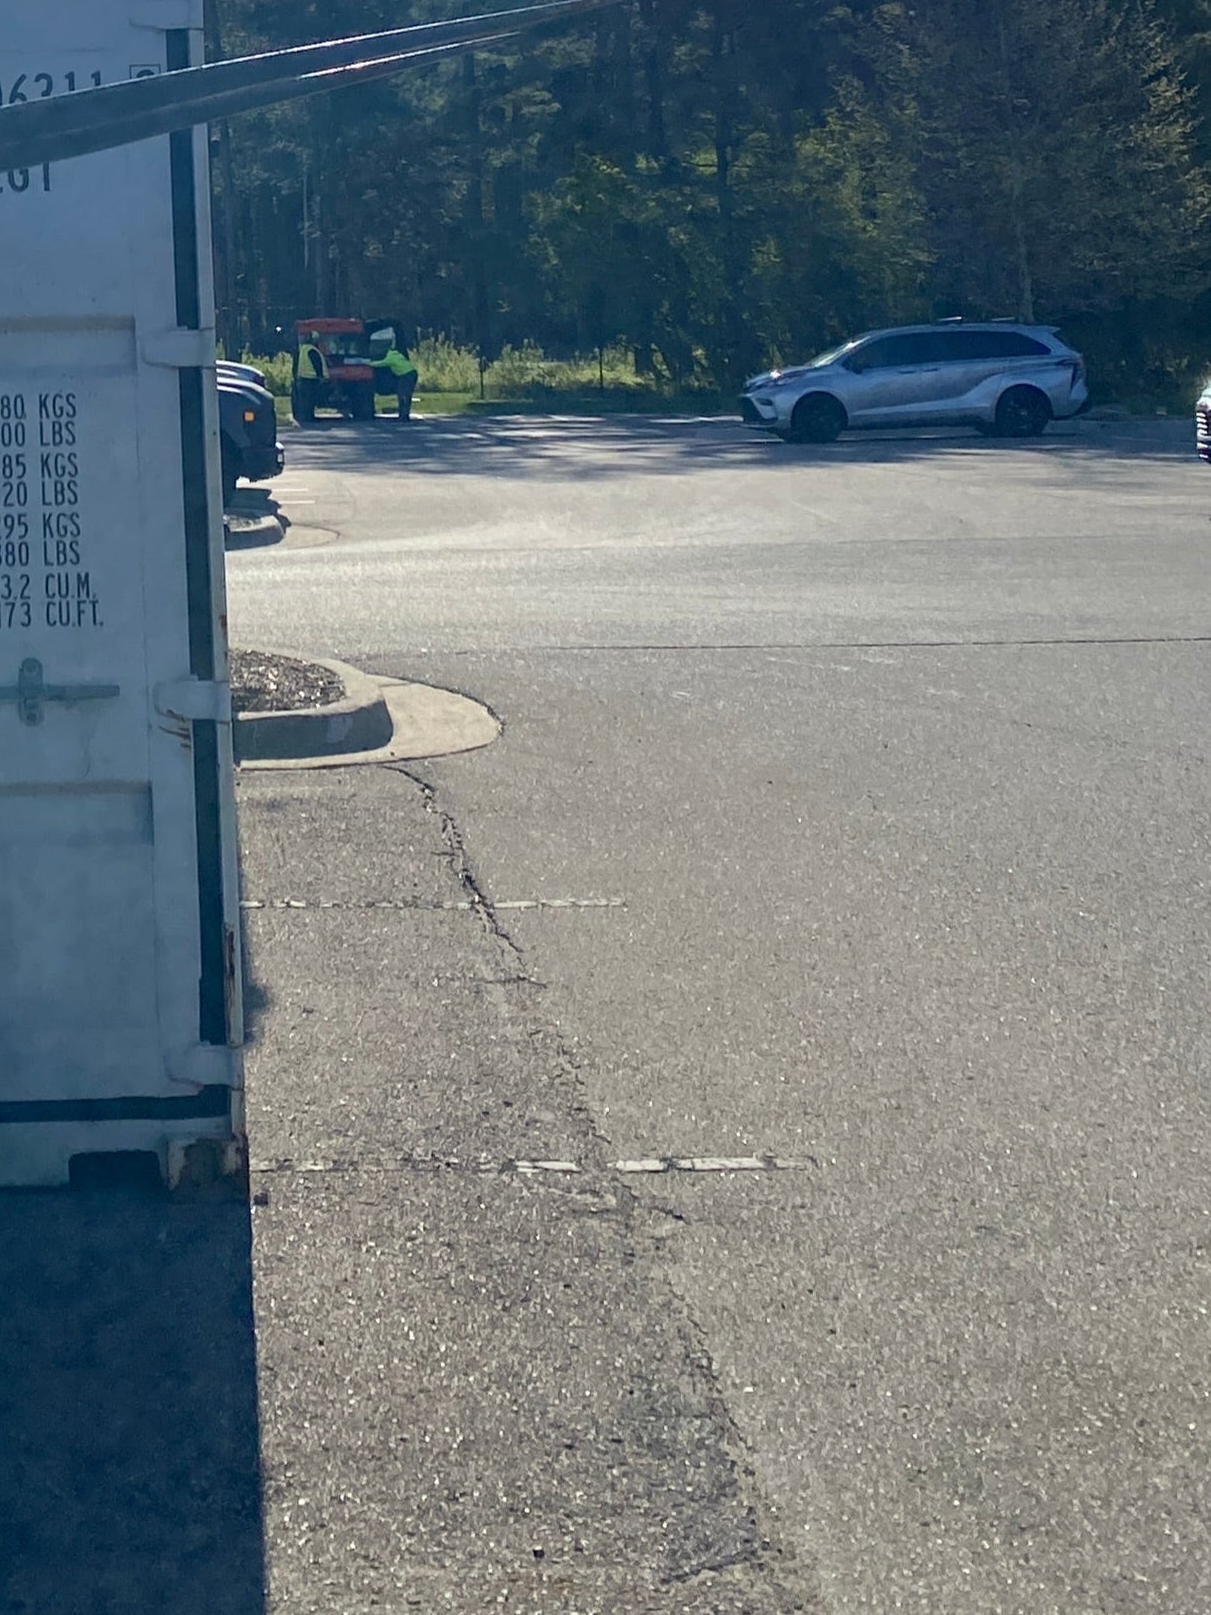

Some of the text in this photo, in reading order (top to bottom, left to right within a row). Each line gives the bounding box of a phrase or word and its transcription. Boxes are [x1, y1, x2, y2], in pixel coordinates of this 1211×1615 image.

[38, 393, 77, 420] KGS
[39, 420, 77, 447] LBS
[40, 452, 79, 479] KGS
[41, 480, 79, 507] LBS
[42, 512, 81, 539] KGS
[43, 540, 81, 567] LBS
